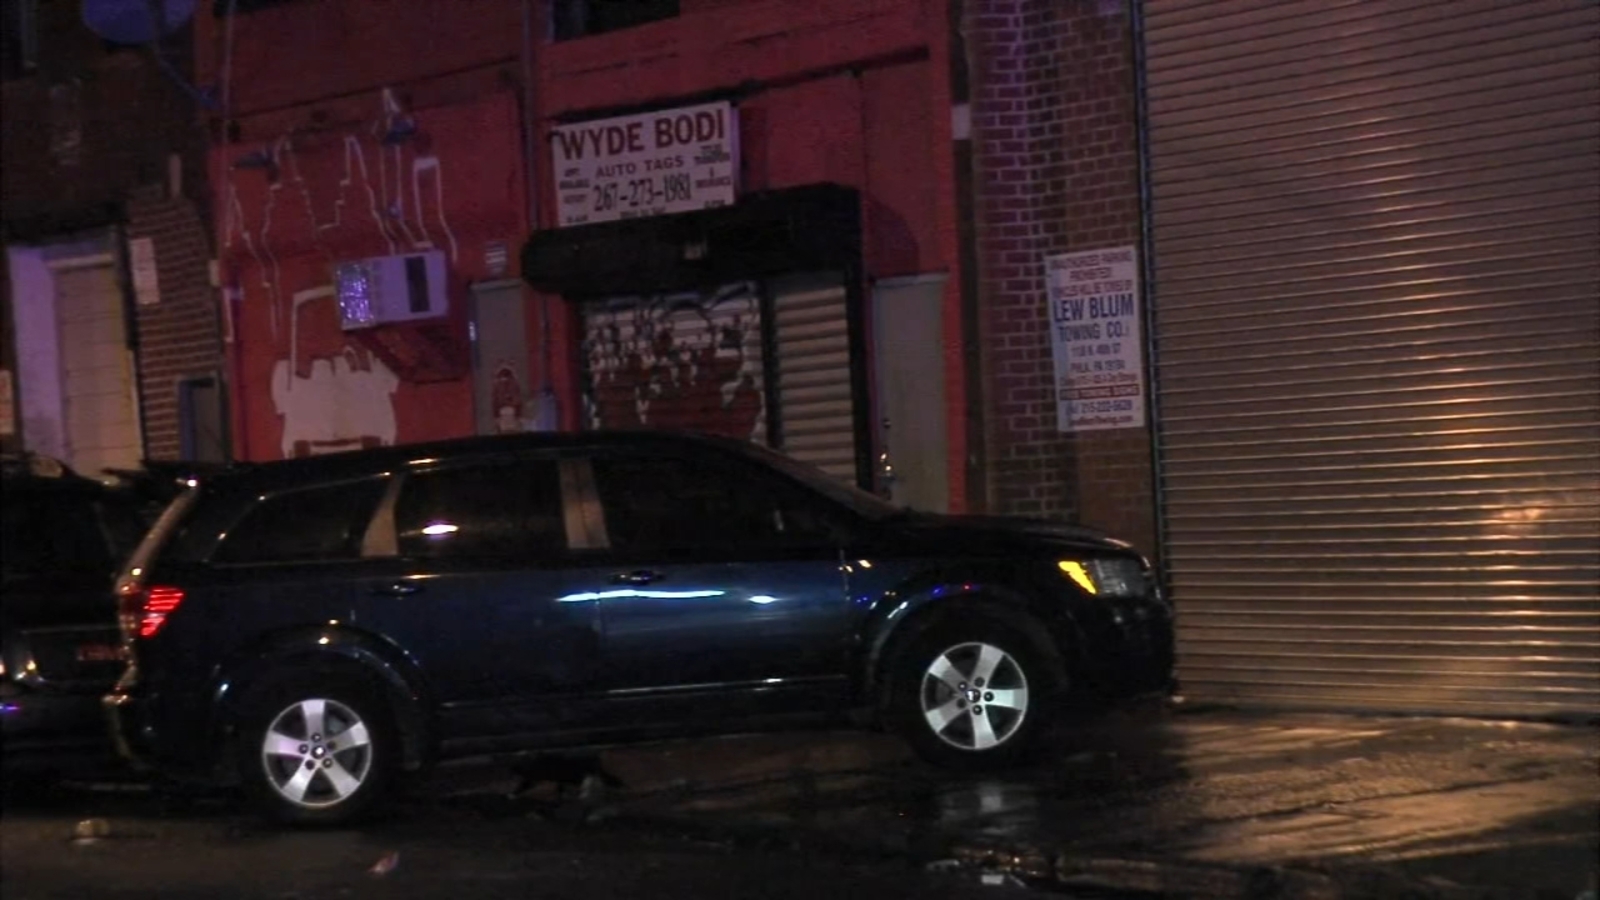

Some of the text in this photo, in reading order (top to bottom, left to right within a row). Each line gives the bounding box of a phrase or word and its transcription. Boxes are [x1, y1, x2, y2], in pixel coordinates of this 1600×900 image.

[559, 109, 724, 160] WYDE BODI
[595, 163, 636, 178] AUTO
[644, 155, 684, 171] TAGS
[593, 172, 692, 211] 267-273-1981
[1053, 293, 1134, 322] LEW BLUM
[1058, 323, 1100, 342] TOWING
